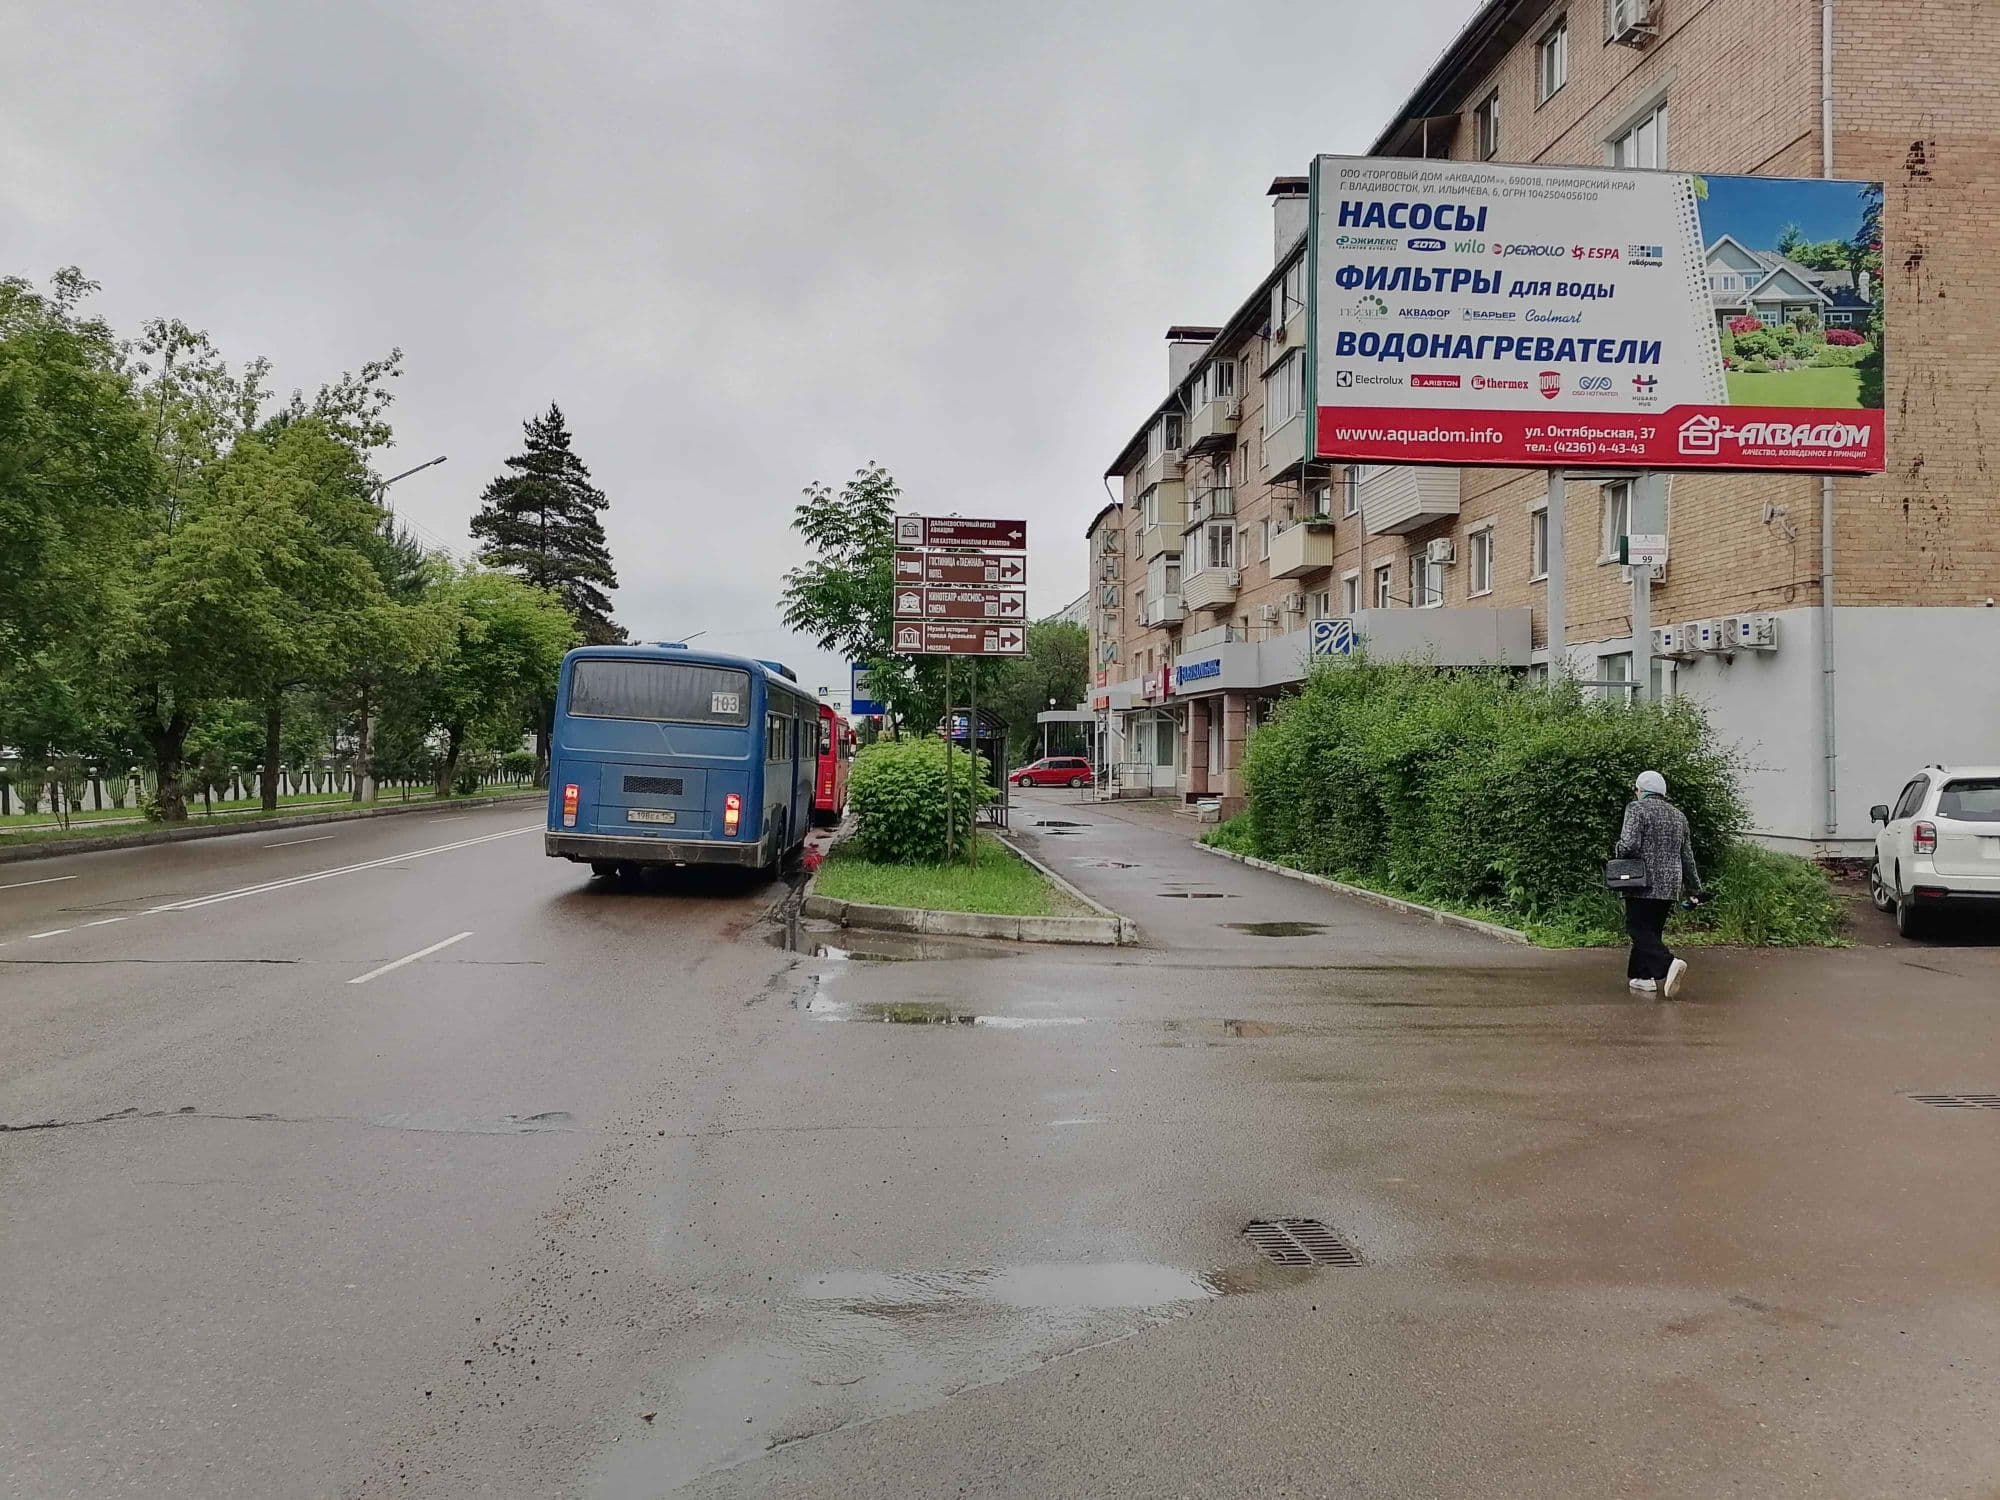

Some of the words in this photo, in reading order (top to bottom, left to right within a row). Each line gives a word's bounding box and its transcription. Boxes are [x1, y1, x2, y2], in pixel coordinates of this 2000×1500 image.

[1340, 168, 1360, 178] ООО
[1362, 169, 1418, 181] «ТОРГОВЫЙ
[1420, 171, 1443, 182] ДОМ
[1545, 177, 1609, 190] ПРИМОРСКИЙ
[1612, 179, 1636, 191] КРАЙ
[1502, 188, 1527, 198] ОГРН
[1338, 201, 1488, 232] НАСОСЫ
[1411, 240, 1442, 249] ZOTA
[1454, 239, 1486, 254] wilo
[1587, 247, 1620, 260] ESPA
[1335, 265, 1502, 294] ФИЛЬТРЫ
[1398, 308, 1450, 318] АКВАФОР
[1473, 310, 1516, 319] БАРЬЕР
[1525, 308, 1582, 323] Coolmart
[1336, 331, 1662, 364] ВОДОНАГРЕВАТЕЛИ
[1355, 374, 1404, 385] Electrolux
[1423, 379, 1459, 387] ARISTON
[1487, 377, 1529, 389] thermex
[1335, 426, 1503, 444] www.aquadom.info
[1524, 426, 1545, 439] ул.
[1547, 424, 1639, 441] Октябрьская,
[1640, 427, 1656, 440] 37
[1738, 421, 1871, 449] АКВАДОМ
[1524, 442, 1551, 453] тел.:
[1553, 442, 1597, 454] (42361)
[1598, 442, 1645, 454] 4-43-43
[1742, 448, 1778, 457] КАЧЕСТВО,
[1779, 449, 1827, 457] ВОЗВЕДЕННОЕ
[1833, 450, 1867, 459] ПРИНЦИП
[928, 556, 955, 567] ГОСТИНИЦА
[1642, 555, 1653, 563] 99
[928, 569, 943, 578] HOTEL
[928, 592, 957, 601] КИНОТЕАТР
[1102, 530, 1119, 664] КНИГИ
[928, 604, 946, 613] CINEMA
[927, 625, 945, 633] Музей
[713, 696, 738, 712] 103
